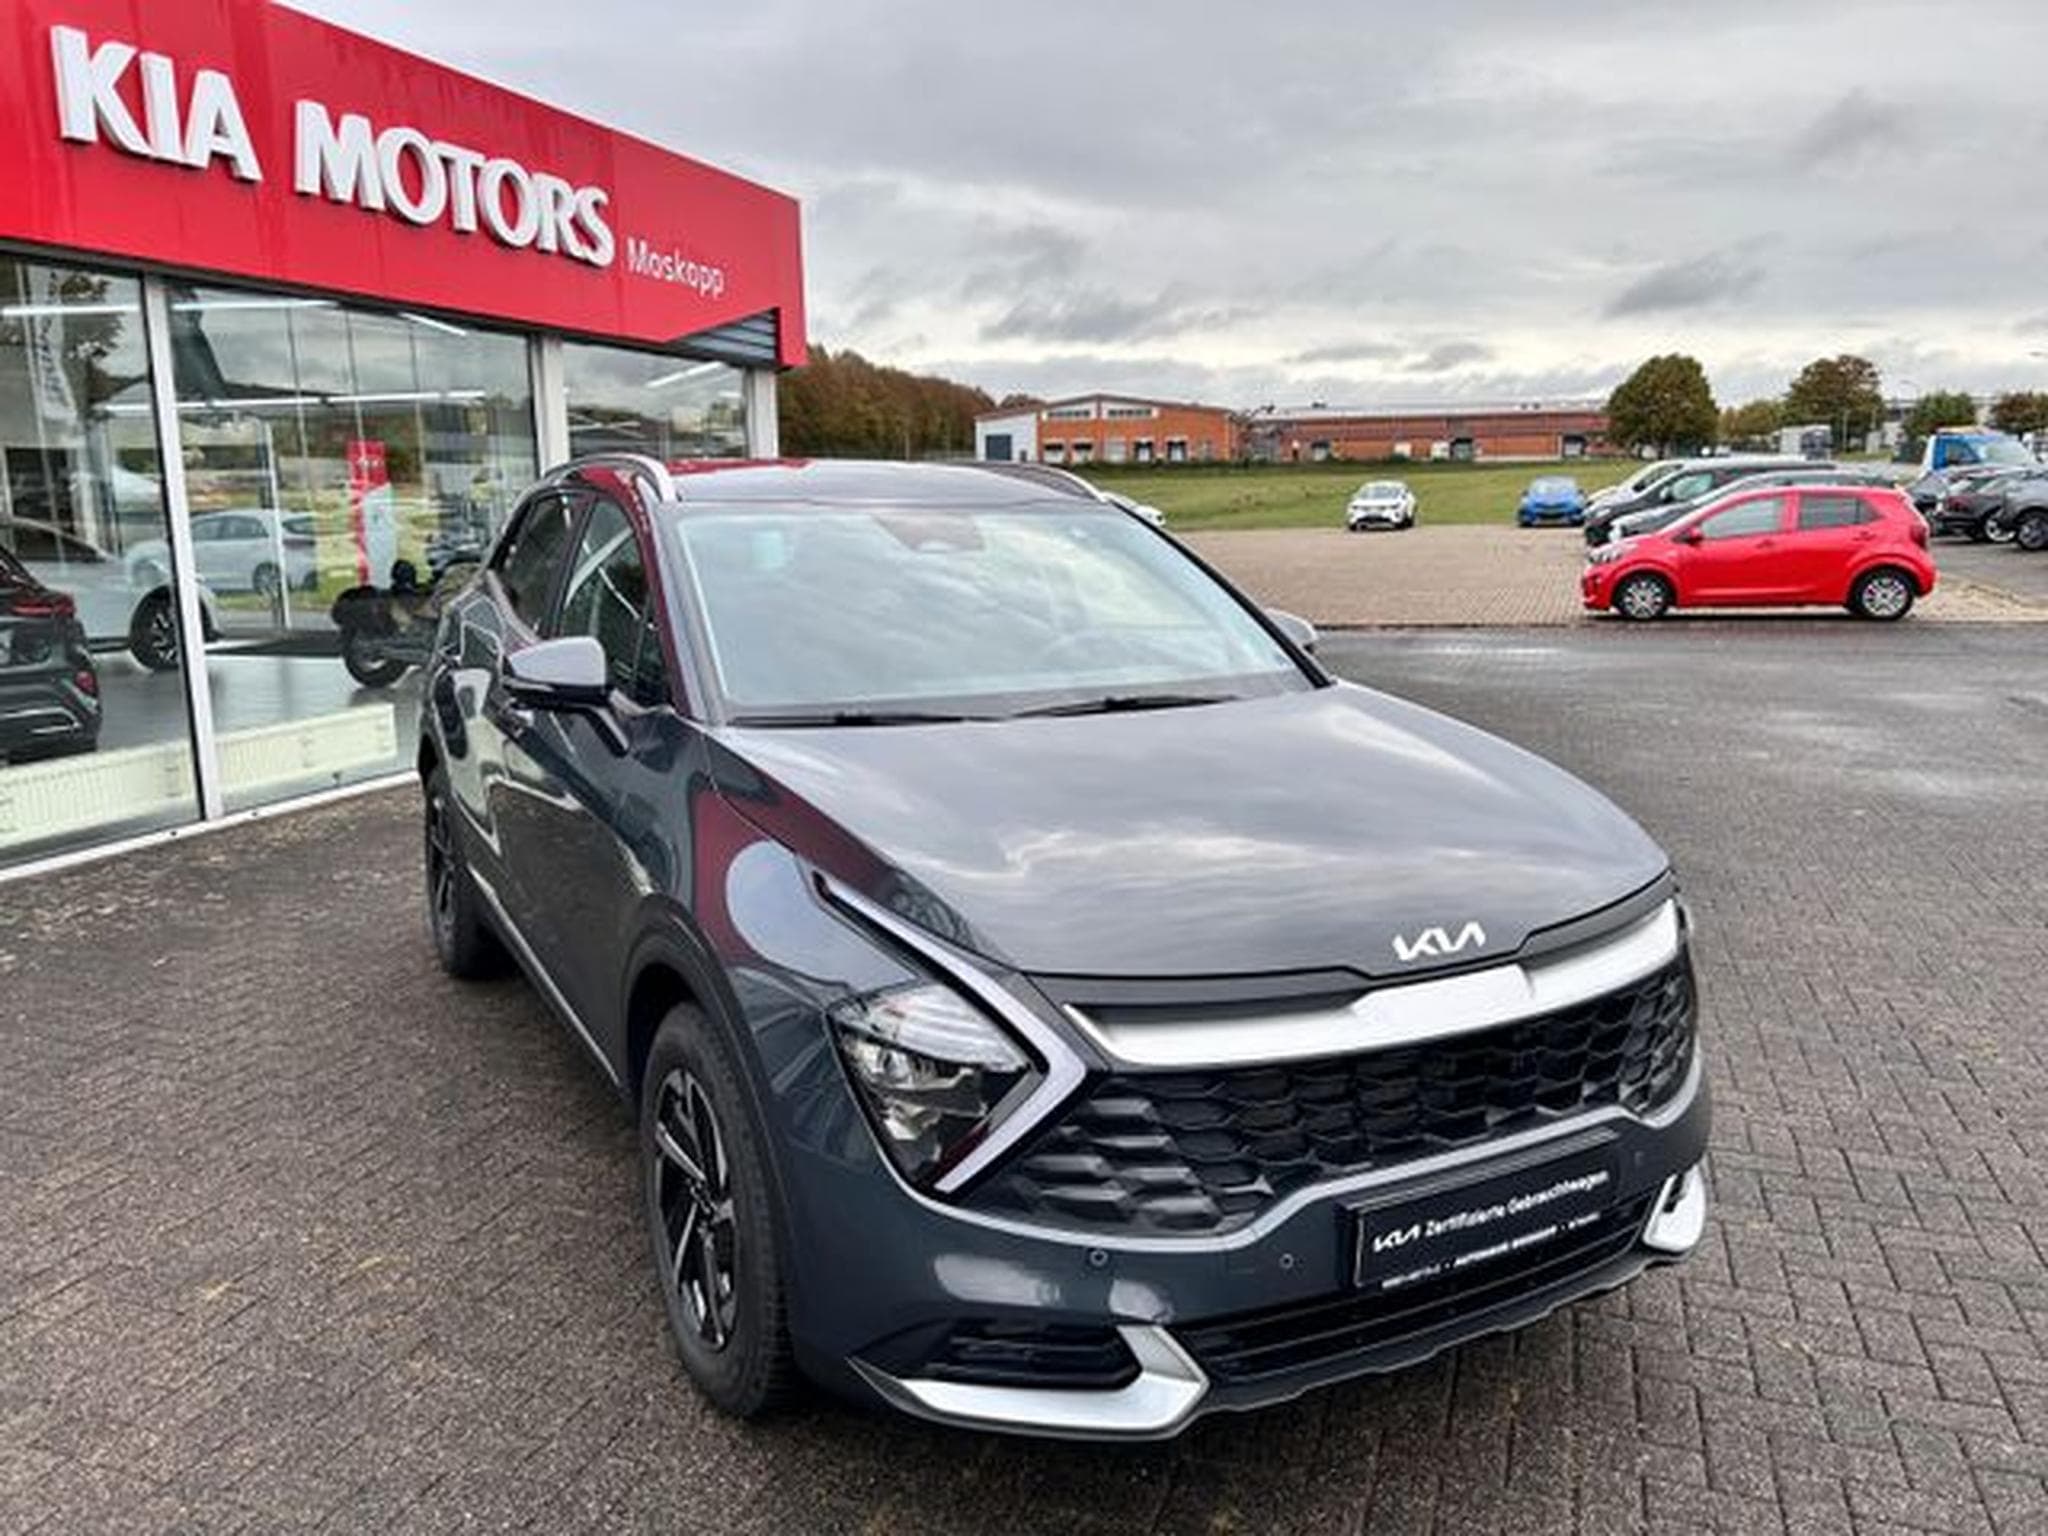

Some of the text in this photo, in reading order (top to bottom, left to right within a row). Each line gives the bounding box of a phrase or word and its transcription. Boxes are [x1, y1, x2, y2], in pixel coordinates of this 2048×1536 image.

[51, 25, 615, 268] KIA MOTORS
[627, 237, 724, 300] Moskopp
